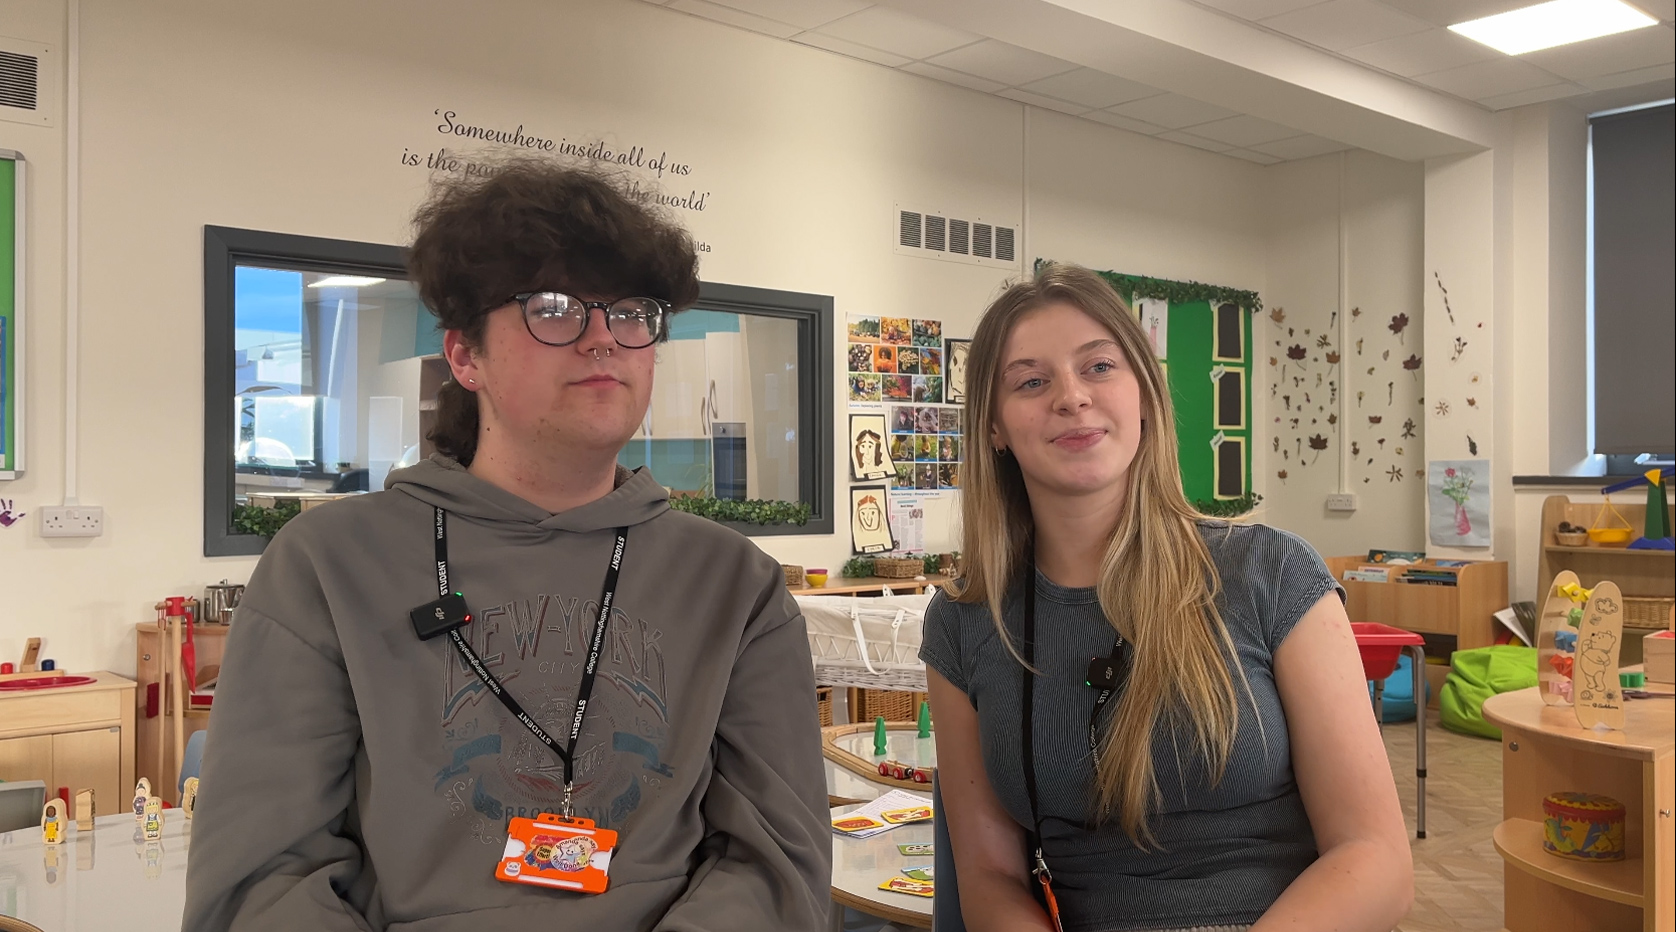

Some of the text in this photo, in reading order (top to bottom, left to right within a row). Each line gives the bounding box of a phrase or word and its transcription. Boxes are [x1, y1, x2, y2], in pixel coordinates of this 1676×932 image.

[401, 147, 422, 167] is
[427, 149, 461, 173] the
[559, 137, 616, 162] inside
[617, 145, 646, 168] all
[648, 152, 669, 179] of
[670, 163, 692, 177] us
[611, 535, 625, 571] STUDENT
[437, 560, 449, 596] STUDENT
[603, 591, 612, 608] West
[458, 641, 490, 683] Nottinghamshire
[586, 652, 599, 675] College
[488, 679, 501, 695] West
[517, 713, 552, 745] STUDENT
[570, 699, 586, 741] STUDENT
[539, 845, 552, 853] Super
[556, 839, 579, 849] Amanda
